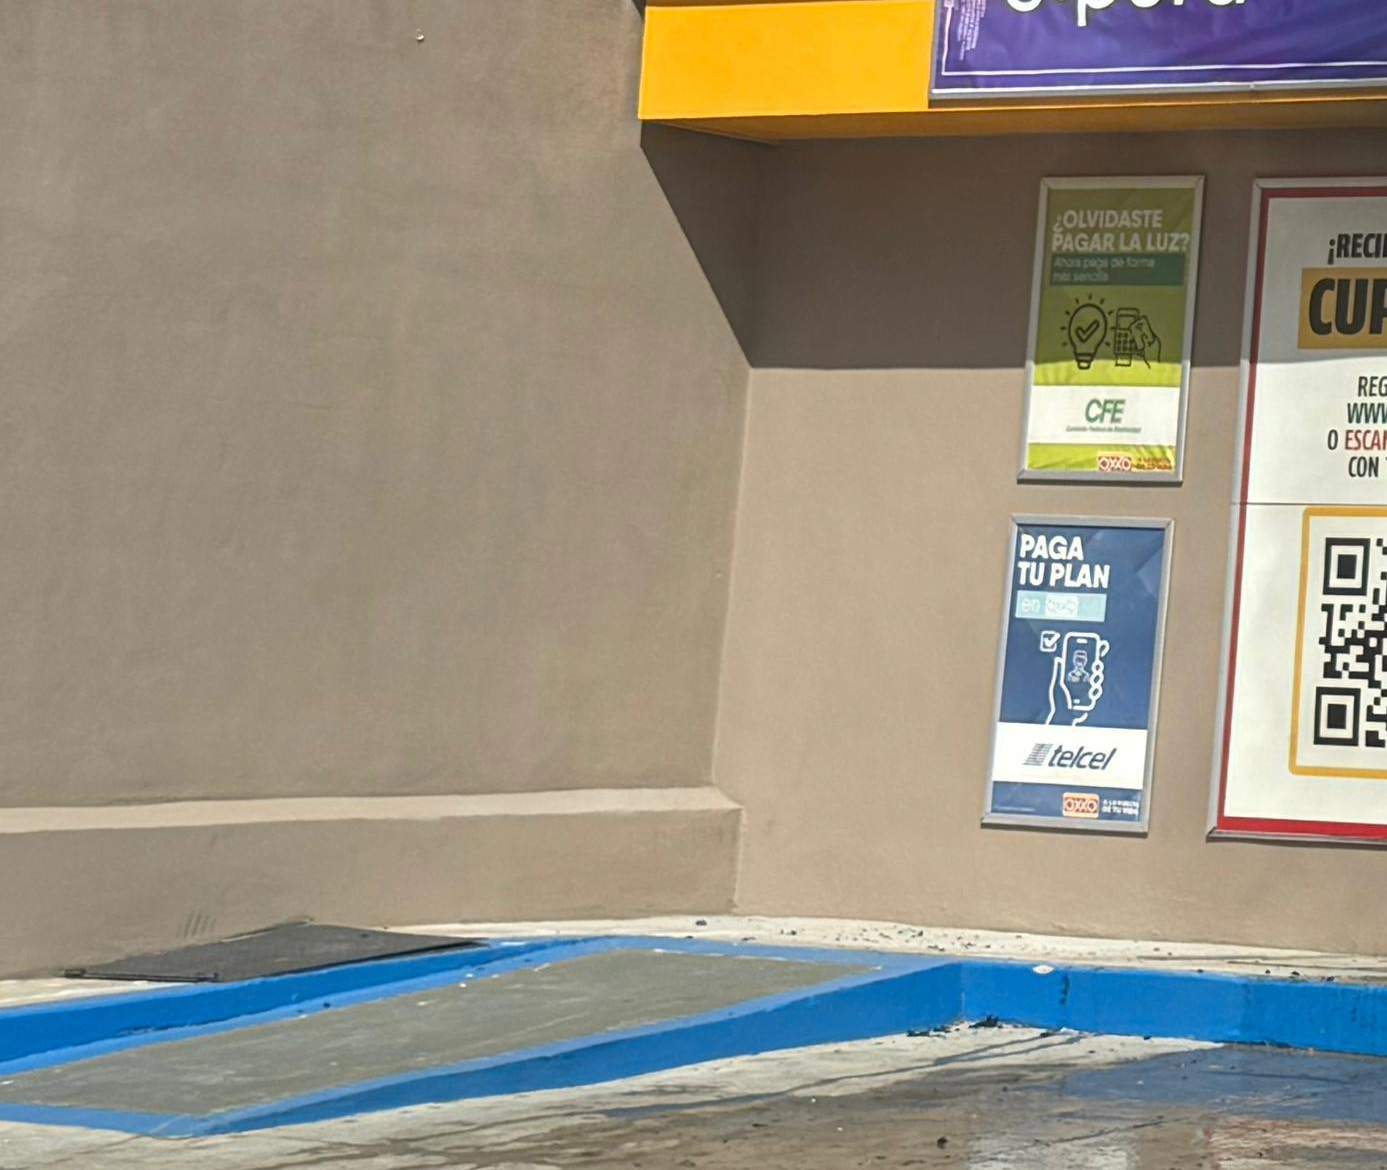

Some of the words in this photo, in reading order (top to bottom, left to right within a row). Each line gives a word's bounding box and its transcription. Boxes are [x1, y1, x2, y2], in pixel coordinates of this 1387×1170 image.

[1052, 210, 1163, 233] ¿OLVIDASTE
[1052, 233, 1115, 252] PAGAR
[1119, 233, 1141, 252] LA
[1146, 233, 1191, 252] LUZ?
[1085, 398, 1126, 424] CFE
[1327, 429, 1339, 451] O
[1098, 456, 1132, 471] OXXO
[1347, 457, 1382, 479] CON
[1019, 533, 1085, 560] PAGA
[1017, 561, 1046, 587] TU
[1049, 562, 1110, 589] PLAN
[1048, 744, 1117, 770] telcel
[1064, 797, 1098, 813] OXXO
